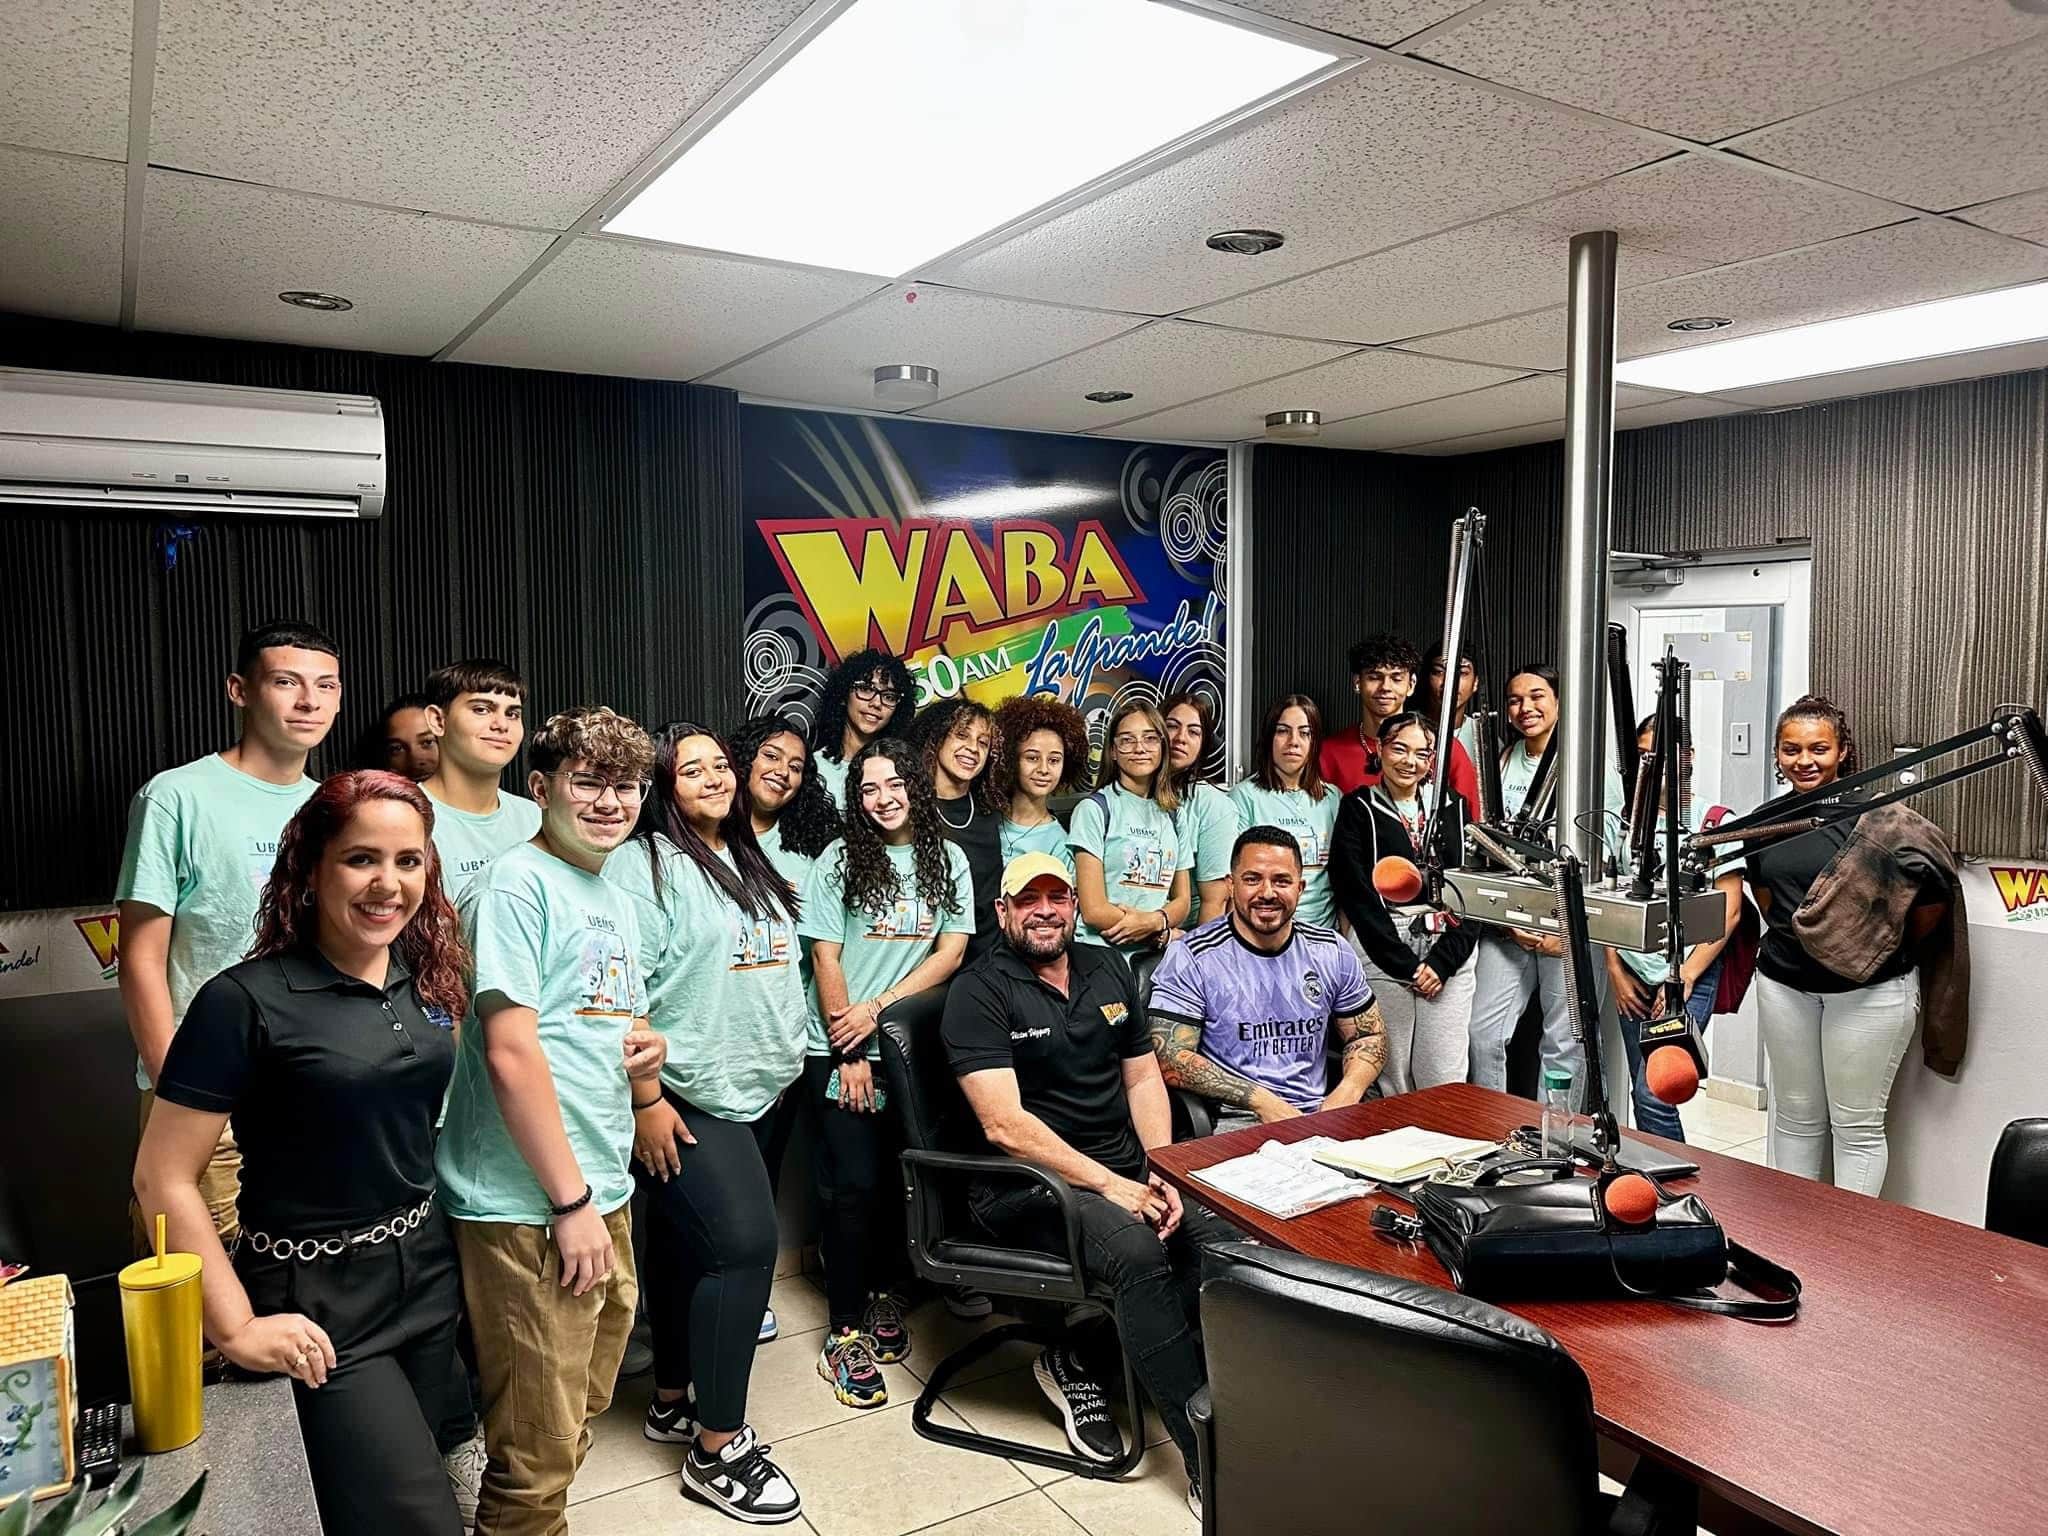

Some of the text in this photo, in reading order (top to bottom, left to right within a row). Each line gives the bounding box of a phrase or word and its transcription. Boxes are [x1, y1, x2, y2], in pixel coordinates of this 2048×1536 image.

[773, 528, 1136, 665] WABA
[255, 841, 277, 853] UB
[1238, 1015, 1324, 1041] Emirates
[1252, 1035, 1314, 1058] FLY BETTER
